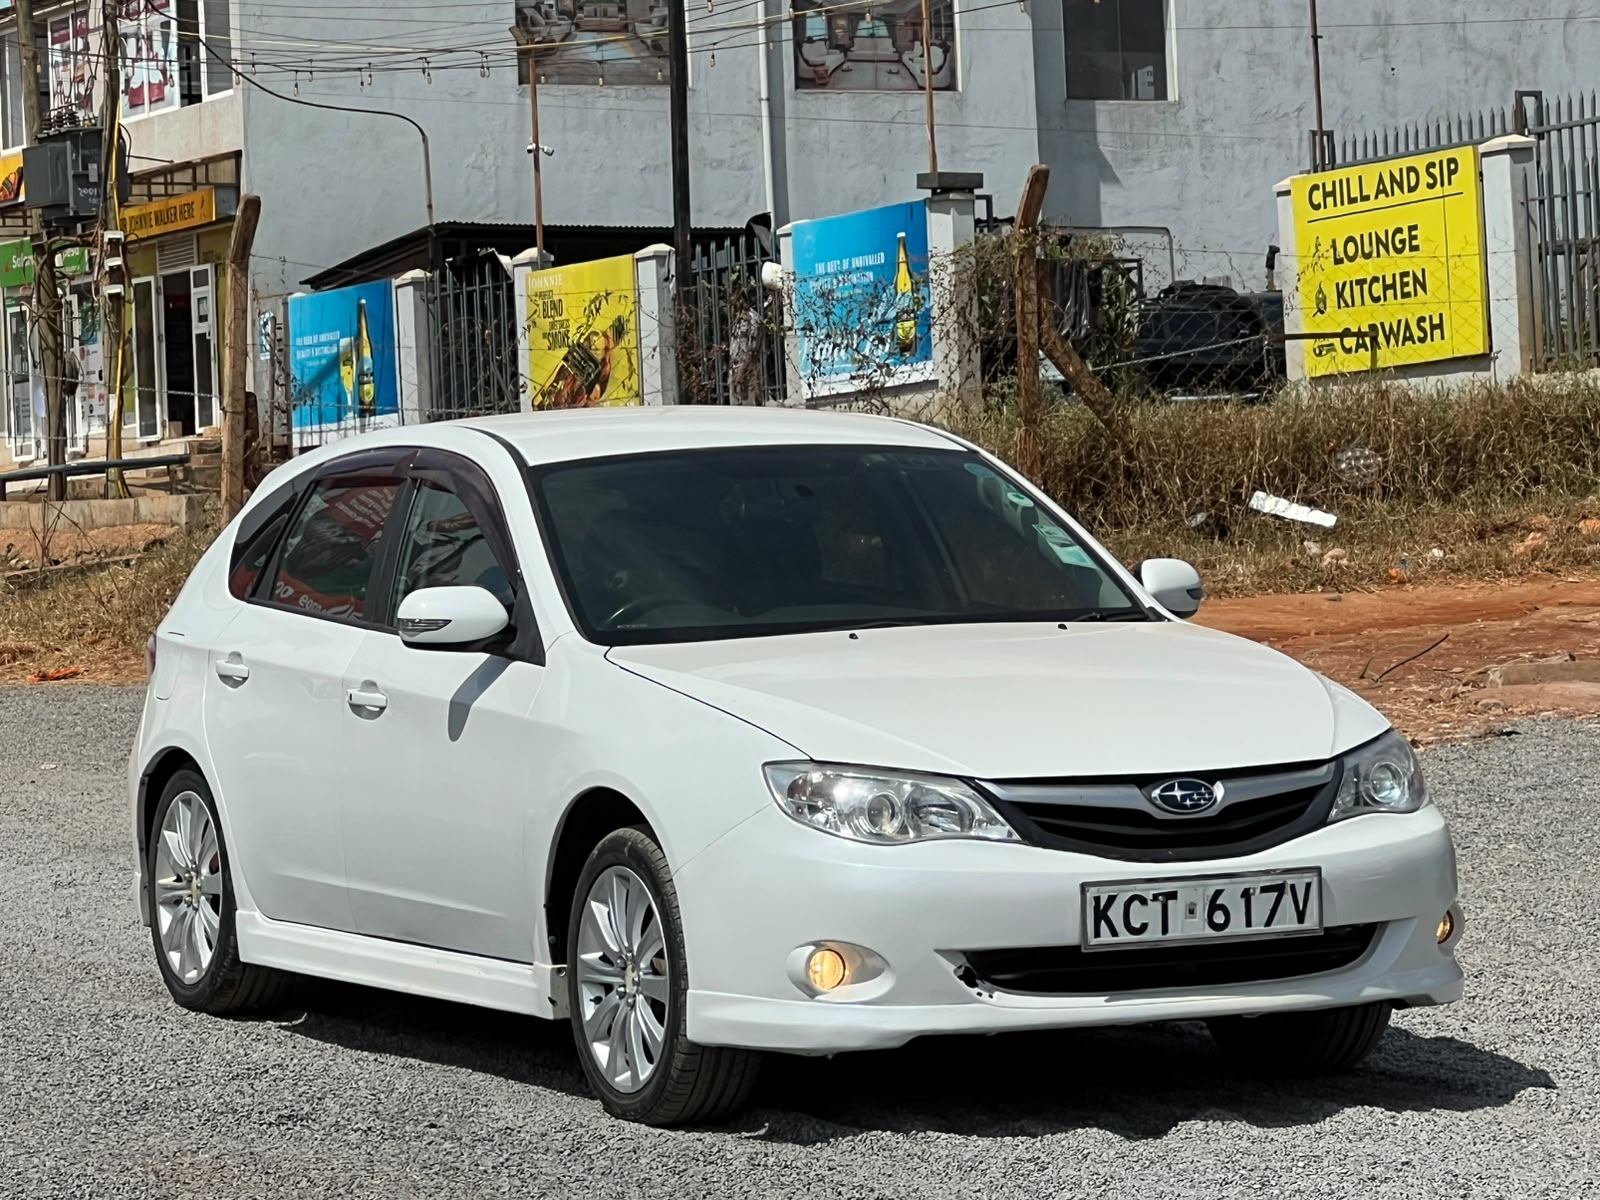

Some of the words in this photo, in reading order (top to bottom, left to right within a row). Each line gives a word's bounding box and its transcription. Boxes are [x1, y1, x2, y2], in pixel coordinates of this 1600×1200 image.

[1308, 175, 1371, 211] CHILL
[1374, 165, 1420, 201] AND
[1426, 157, 1459, 190] SIP
[178, 201, 195, 220] HERE
[1332, 224, 1420, 266] LOUNGE
[528, 274, 563, 293] JOHNNIE
[1335, 268, 1429, 310] KITCHEN
[542, 298, 564, 319] BLEND
[547, 330, 570, 350] SMOKE
[1340, 313, 1445, 354] CARWASH
[1093, 889, 1178, 939] KCT
[1206, 881, 1312, 933] 617V
